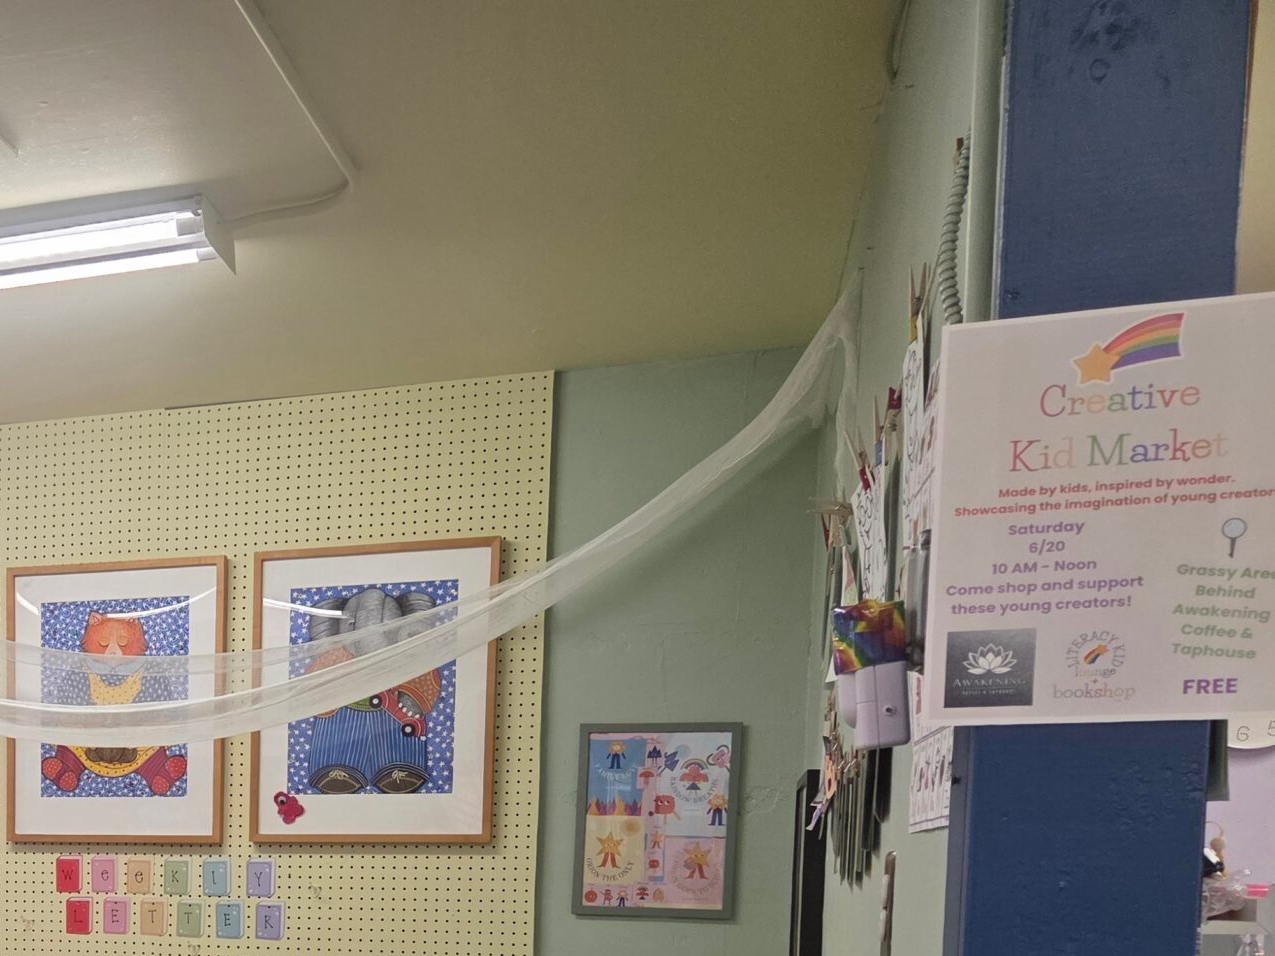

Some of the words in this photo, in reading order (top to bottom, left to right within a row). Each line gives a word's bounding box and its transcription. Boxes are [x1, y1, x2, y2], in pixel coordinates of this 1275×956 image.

[1039, 383, 1202, 418] Creative
[1009, 437, 1076, 473] Kid
[1086, 428, 1229, 467] Market
[998, 487, 1036, 499] Made
[1039, 485, 1057, 498] by
[1060, 482, 1092, 494] kids,
[1095, 478, 1152, 493] inspired
[1156, 476, 1175, 490] by
[1177, 473, 1236, 487] wonder.
[954, 502, 1037, 518] Showcasing
[1039, 501, 1062, 512] the
[1064, 494, 1152, 511] imagination
[1153, 493, 1170, 504] of
[1171, 491, 1218, 506] young
[1007, 521, 1085, 536] Saturday
[1029, 538, 1066, 556] 6/20
[992, 562, 1008, 575] 10
[1012, 562, 1038, 574] AM
[1053, 560, 1097, 572] Noon
[1177, 563, 1238, 581] Grassy
[945, 584, 994, 597] Come
[996, 581, 1038, 596] shop
[1041, 578, 1074, 592] and
[1077, 576, 1144, 592] support
[1194, 584, 1256, 600] Behind
[951, 603, 996, 616] these
[999, 600, 1052, 617] young
[1056, 595, 1132, 611] creators!
[1171, 603, 1271, 624] Awakening
[1180, 624, 1238, 639] Coffee
[1240, 627, 1254, 640] &
[1171, 642, 1258, 660] Taphouse
[1052, 682, 1137, 701] bookshop
[1181, 677, 1239, 695] FREE
[73, 908, 274, 929] LETTER
